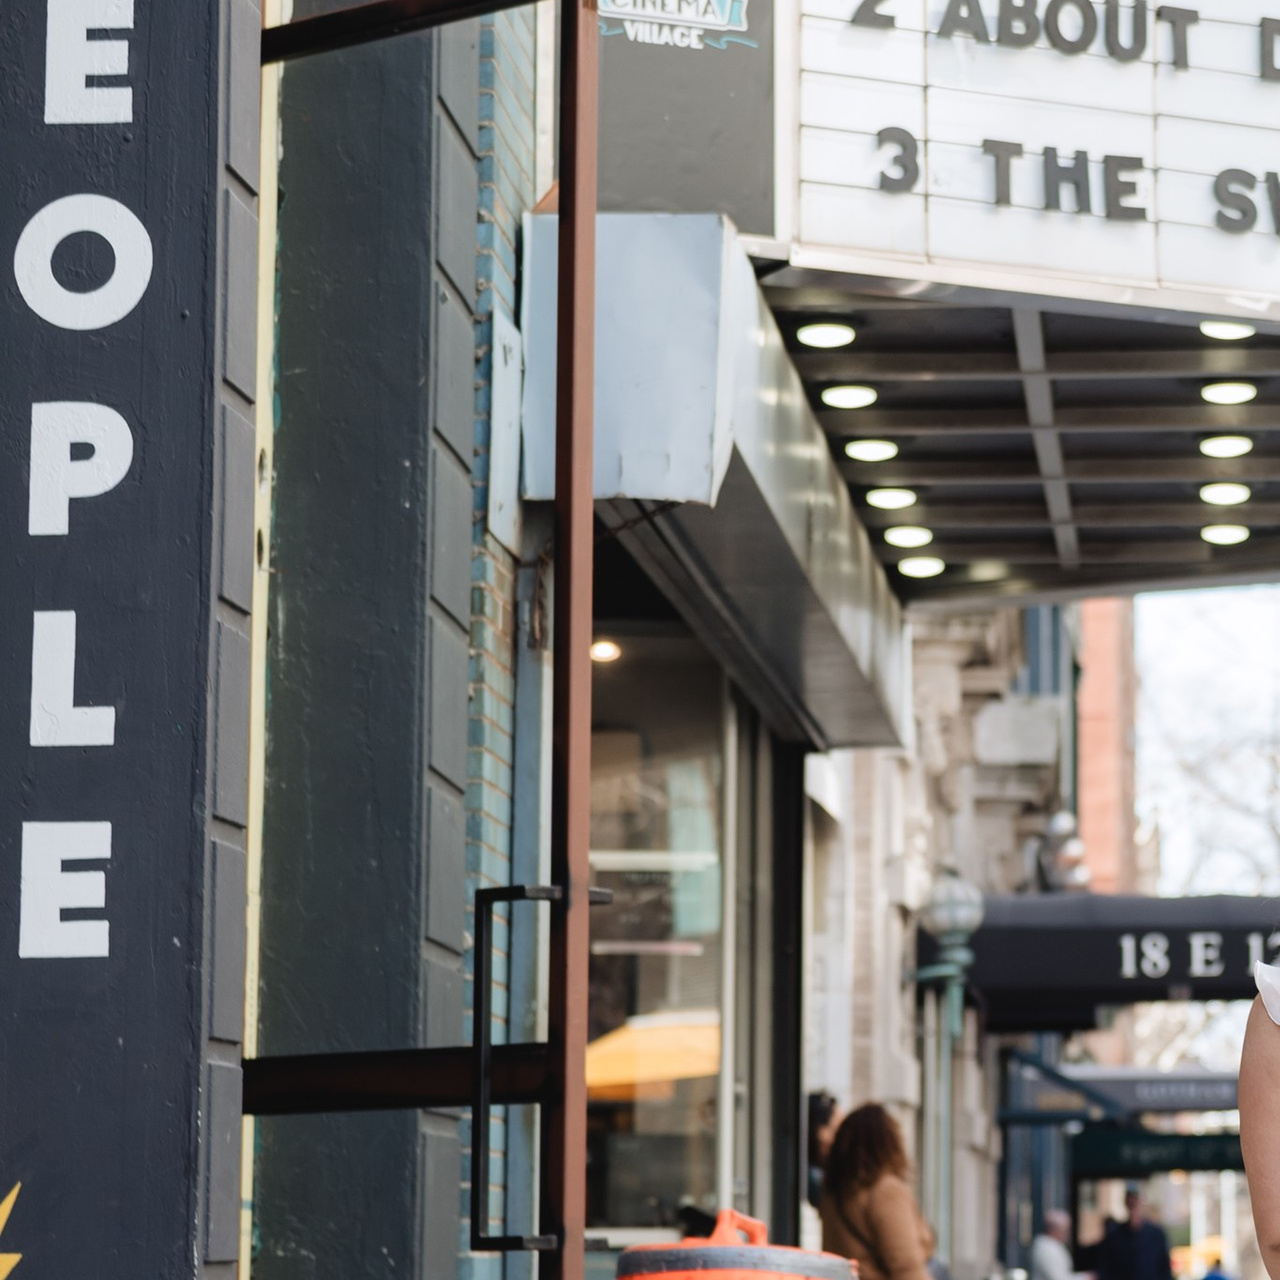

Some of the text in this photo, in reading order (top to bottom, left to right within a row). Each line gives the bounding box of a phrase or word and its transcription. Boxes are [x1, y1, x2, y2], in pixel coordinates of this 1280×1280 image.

[622, 19, 704, 49] VILLAGE
[876, 126, 919, 194] 3
[982, 138, 1147, 222] THE
[1119, 931, 1171, 979] 18
[1188, 931, 1225, 978] E
